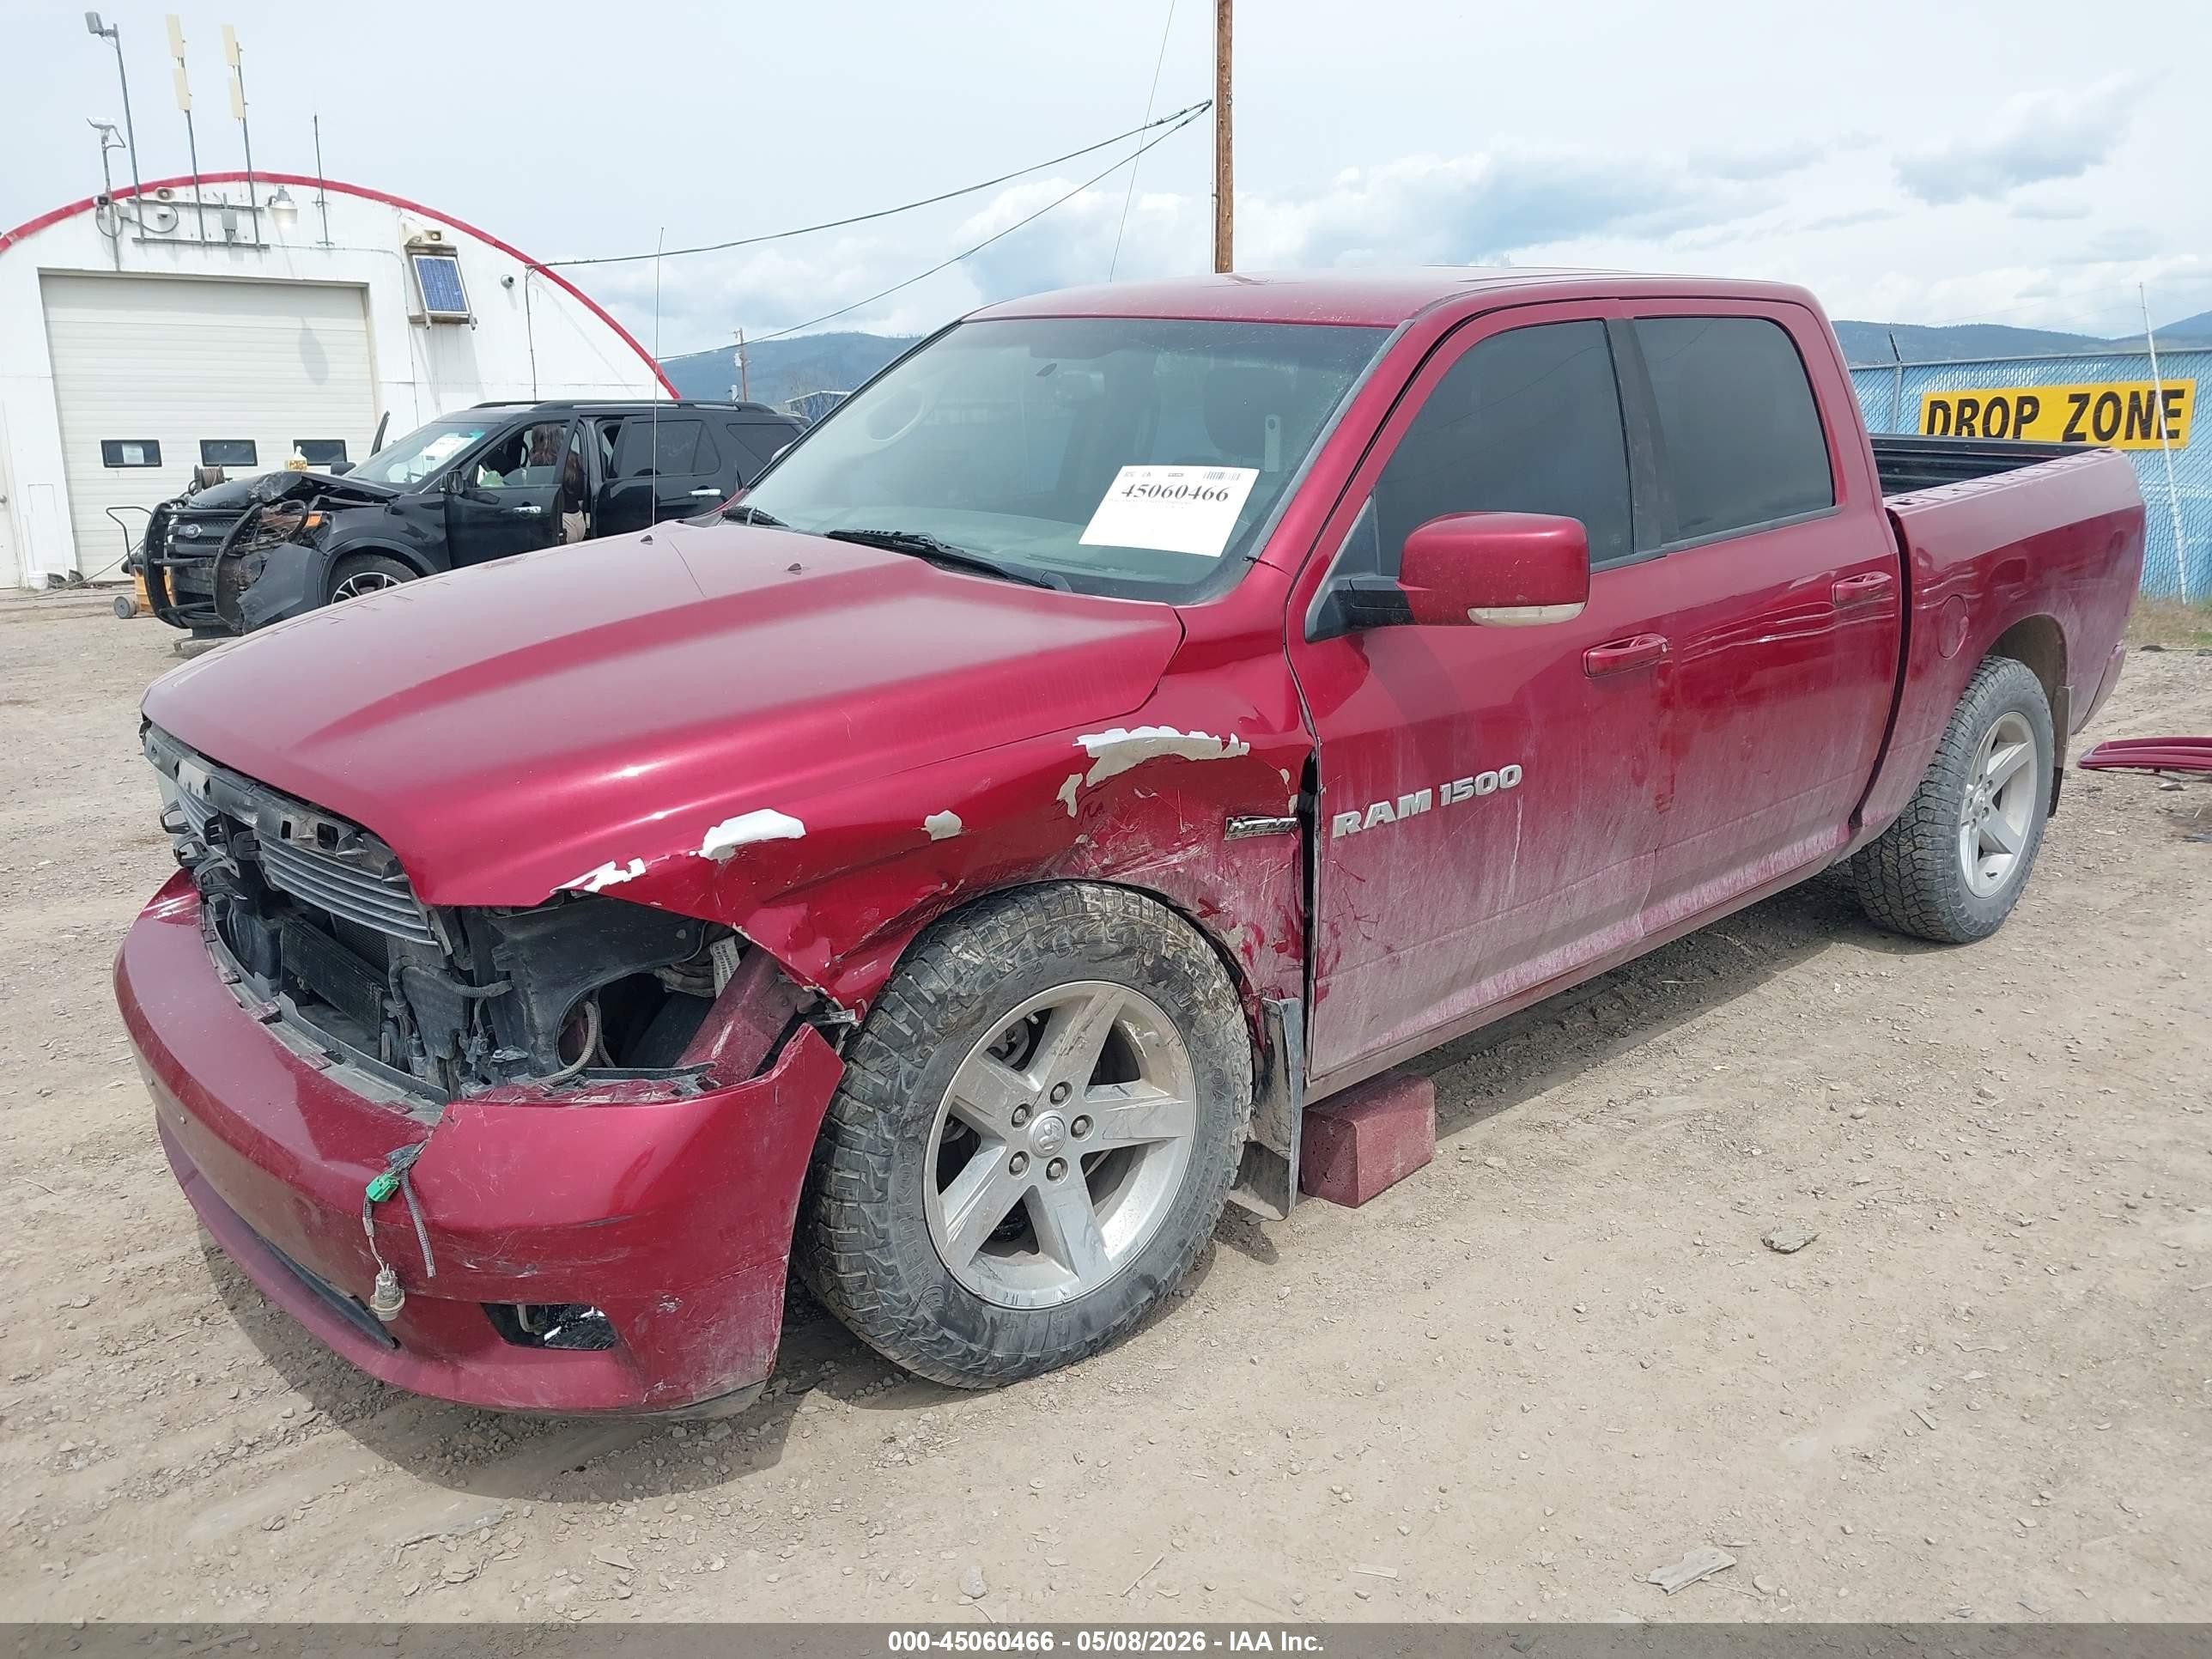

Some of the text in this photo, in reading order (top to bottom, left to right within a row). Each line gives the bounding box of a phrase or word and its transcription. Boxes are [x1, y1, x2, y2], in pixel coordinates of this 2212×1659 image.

[1926, 388, 2186, 442] DROP ZONE
[1121, 483, 1230, 501] 45060466
[1332, 764, 1522, 839] RAM 1500
